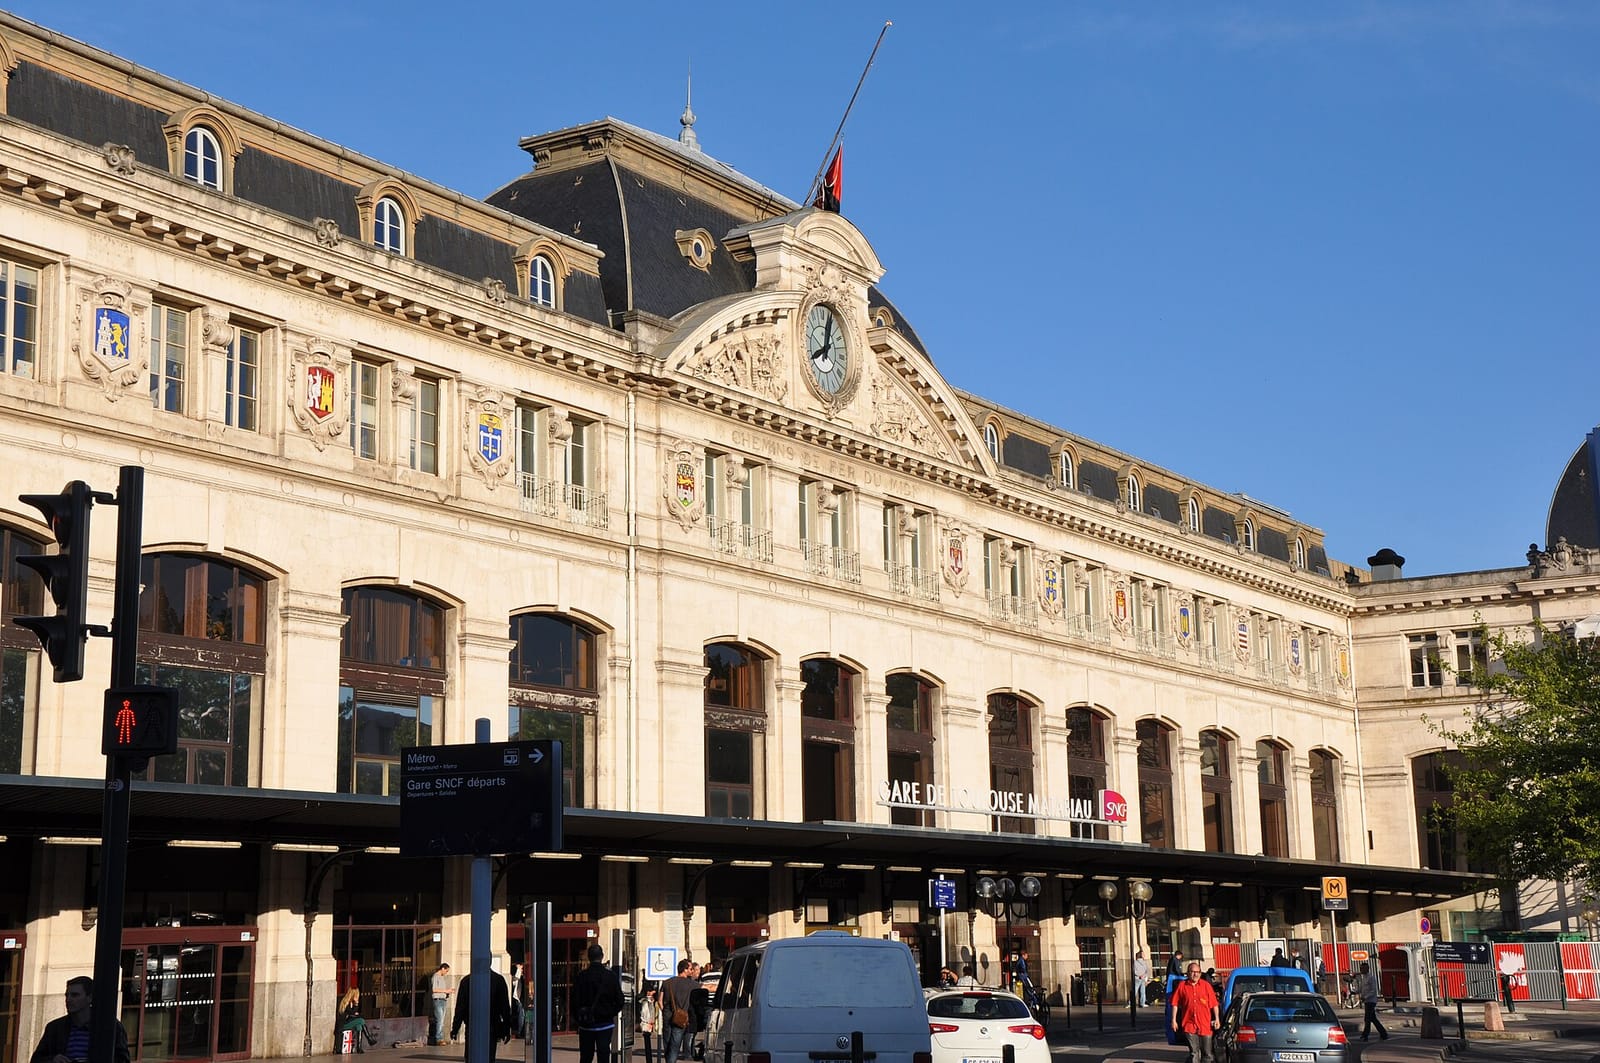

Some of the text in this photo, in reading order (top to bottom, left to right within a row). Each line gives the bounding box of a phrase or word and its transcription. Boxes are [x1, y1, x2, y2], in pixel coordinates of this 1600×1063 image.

[830, 460, 856, 481] FER
[864, 470, 882, 487] DU
[407, 753, 436, 764] Métro
[407, 776, 506, 790] Gare SNCF départs
[879, 779, 921, 804] GARE
[926, 783, 945, 807] DE
[1105, 801, 1127, 817] SNCF
[1329, 882, 1341, 894] M
